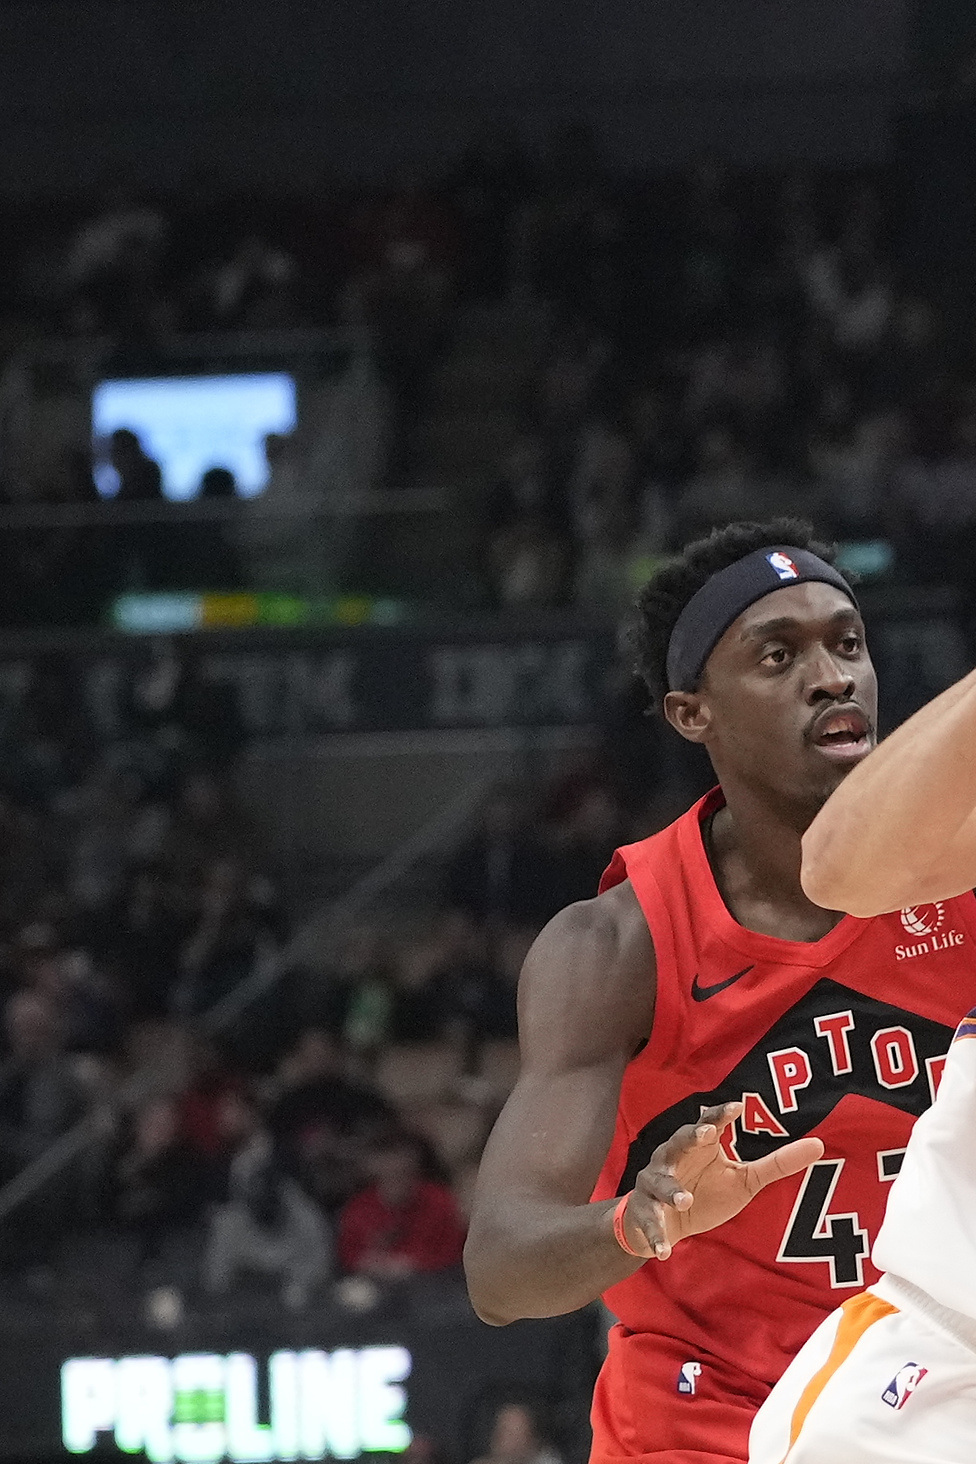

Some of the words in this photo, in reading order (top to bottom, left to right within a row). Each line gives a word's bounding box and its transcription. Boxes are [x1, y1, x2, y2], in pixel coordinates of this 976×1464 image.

[895, 942, 930, 961] Sun
[931, 929, 964, 951] Life
[775, 1146, 907, 1289] 4
